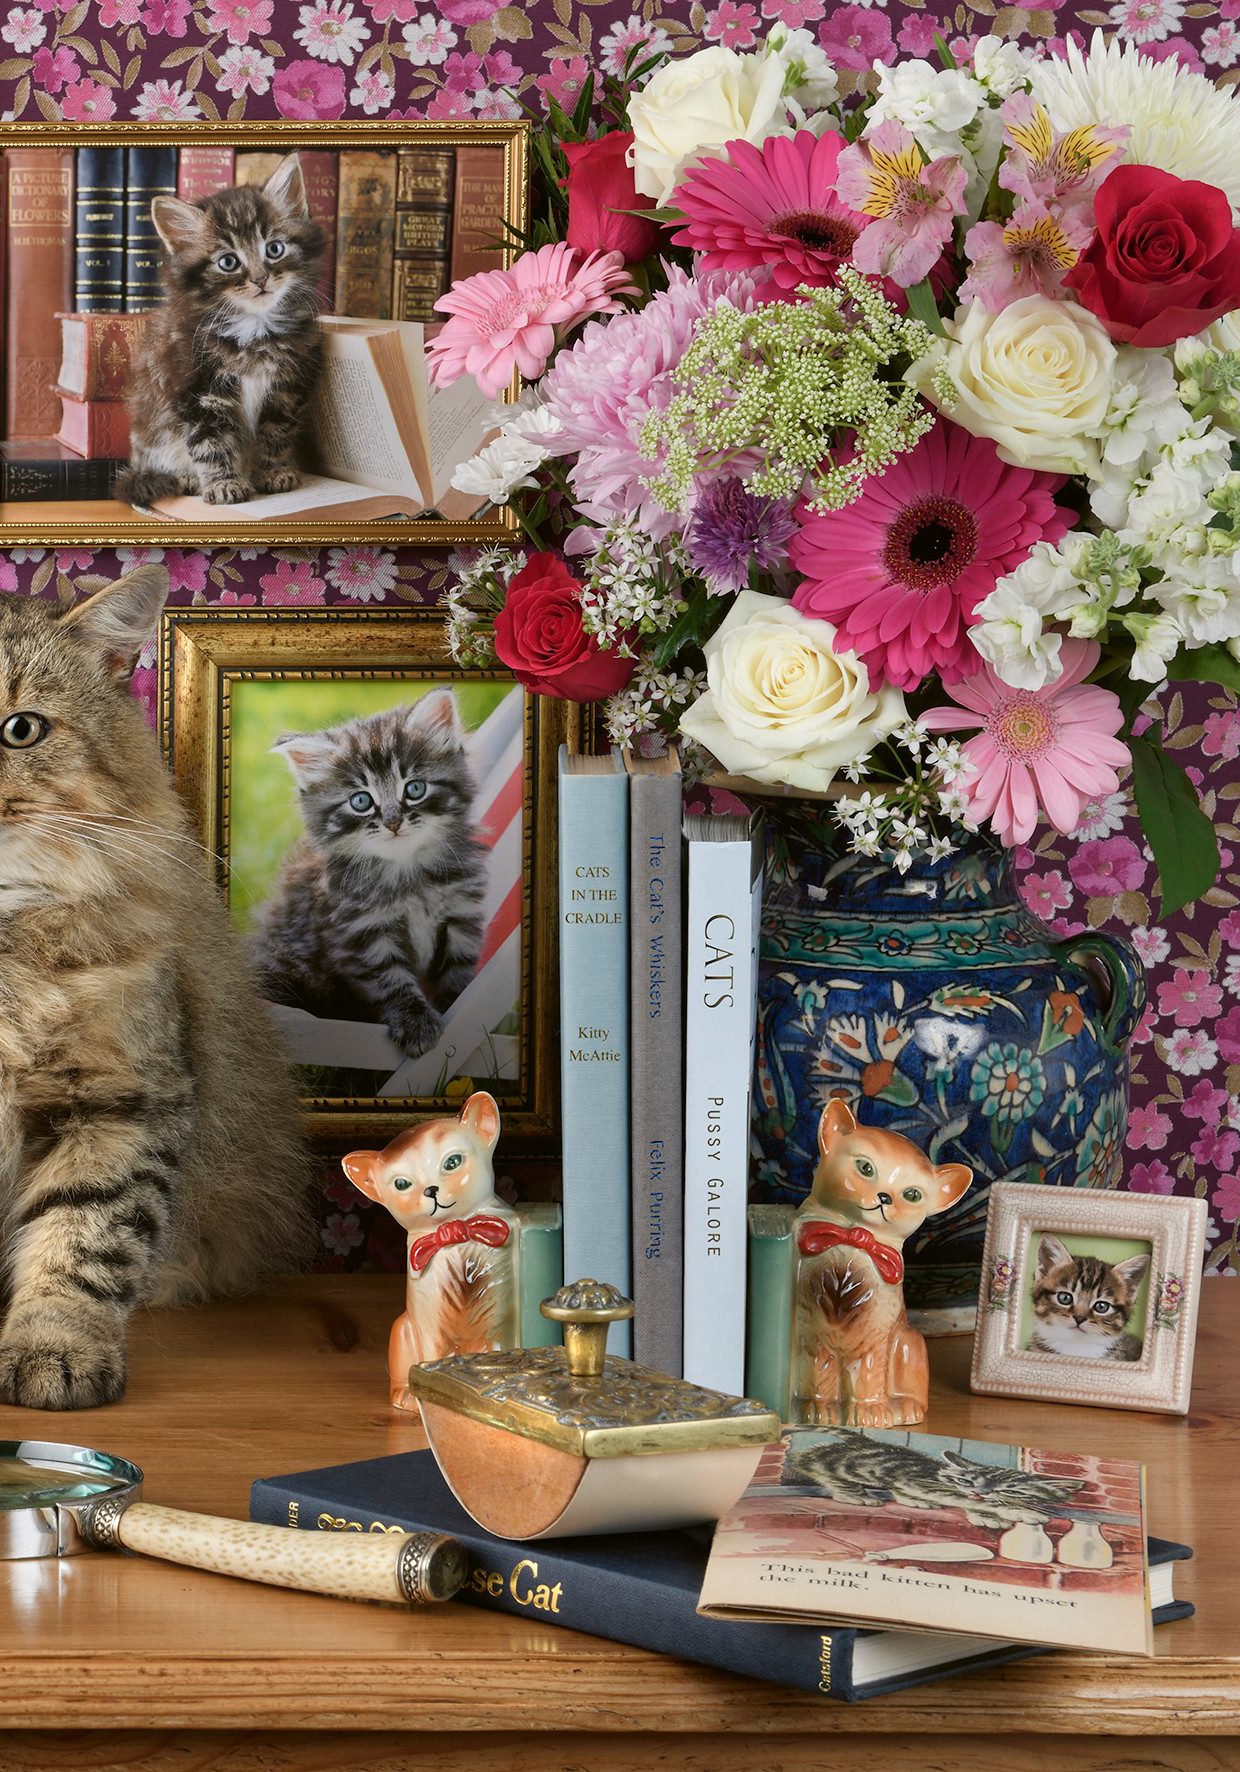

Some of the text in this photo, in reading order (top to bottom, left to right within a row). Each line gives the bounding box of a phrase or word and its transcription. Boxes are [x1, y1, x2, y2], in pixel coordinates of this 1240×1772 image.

[13, 173, 68, 184] A PICTURE
[12, 185, 68, 196] DICTIONARY
[33, 197, 48, 207] OF
[485, 194, 498, 203] OF
[12, 209, 69, 222] FLOWERS
[461, 216, 503, 229] GARDEN
[575, 866, 610, 878] CATS
[571, 889, 617, 900] IN THE
[565, 912, 622, 924] CRADLE
[649, 833, 665, 1019] The Cat's Whiskers
[703, 914, 735, 1009] CATS
[578, 1026, 609, 1041] Kitty
[569, 1050, 621, 1063] McAttie
[707, 1096, 724, 1256] PUSSY GALORE
[646, 1140, 664, 1260] Felix Purring
[288, 1501, 300, 1528] DER
[510, 1559, 563, 1613] Cat
[759, 1574, 870, 1590] the milk.
[761, 1562, 1078, 1609] This bad kitten has upset
